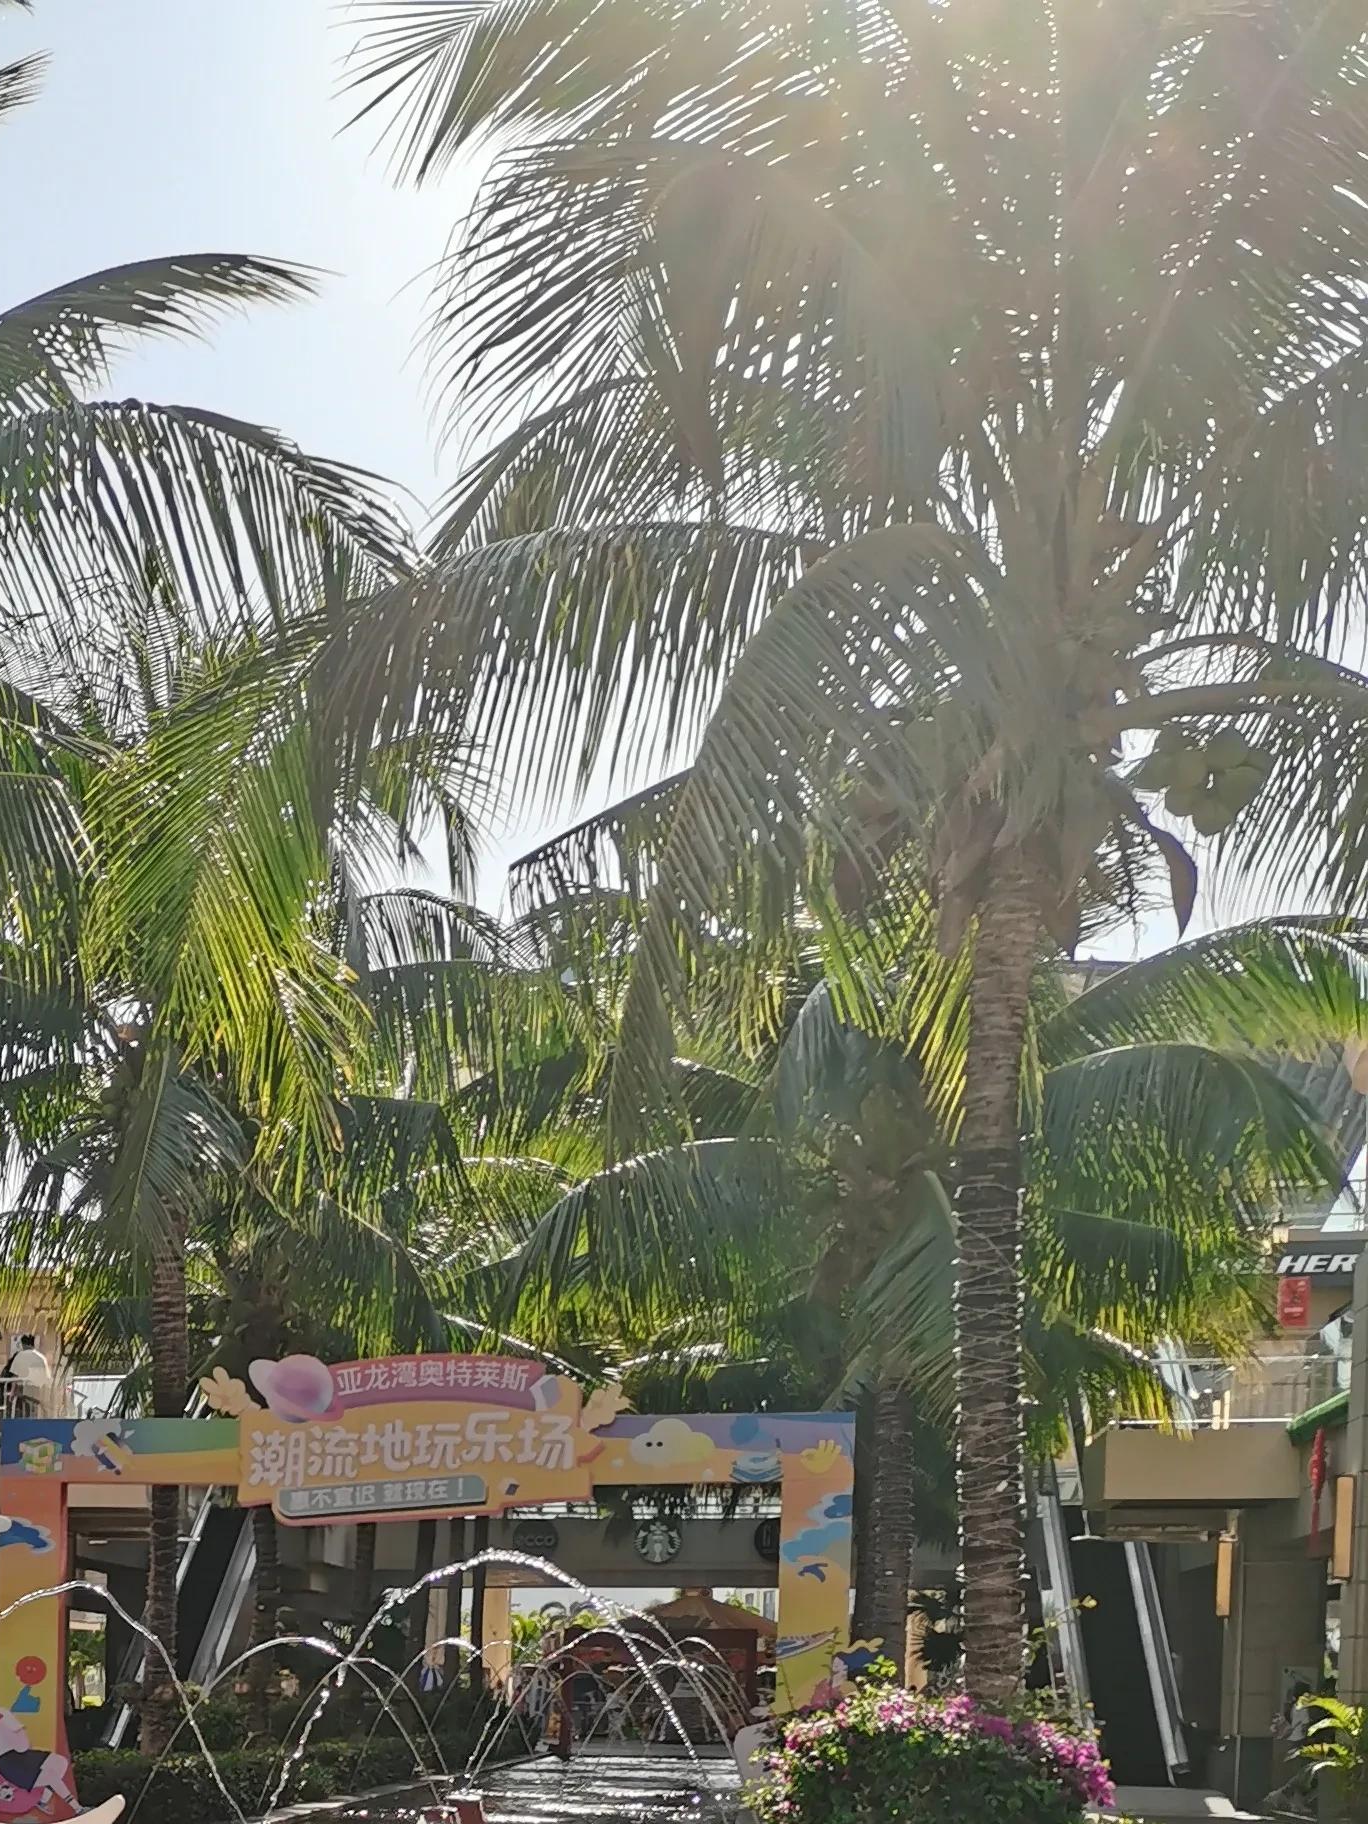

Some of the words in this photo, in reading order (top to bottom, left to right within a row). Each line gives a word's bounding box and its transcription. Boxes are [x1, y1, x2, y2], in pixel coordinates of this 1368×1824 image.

[336, 1360, 530, 1397] 亚龙湾奥特莱斯
[248, 1411, 577, 1487] 潮流地玩乐场
